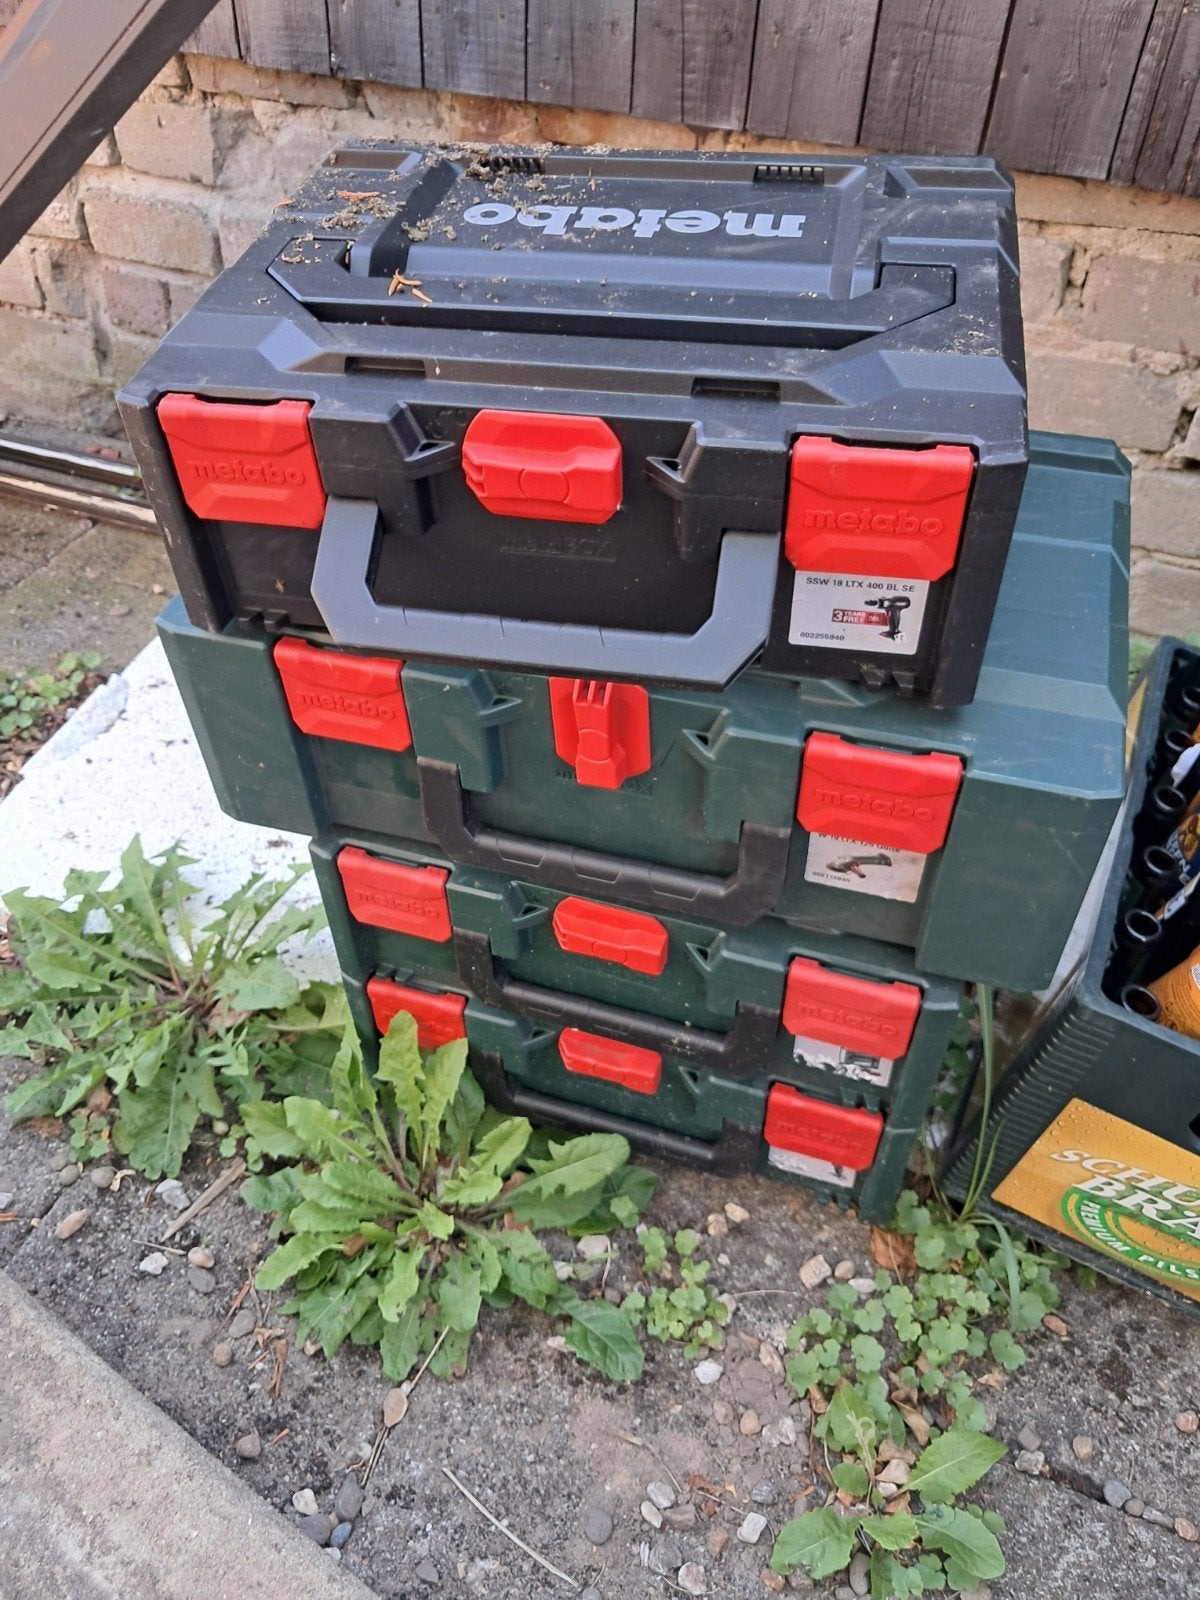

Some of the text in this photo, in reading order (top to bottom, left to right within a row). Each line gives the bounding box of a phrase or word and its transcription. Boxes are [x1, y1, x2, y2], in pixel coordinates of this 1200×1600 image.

[463, 203, 806, 238] metabo
[187, 460, 306, 486] metabo
[804, 509, 943, 536] metabo
[806, 577, 829, 586] SSW
[833, 609, 843, 621] 3
[296, 690, 396, 721] metabo
[813, 788, 935, 823] metabo
[354, 889, 440, 919] metabo
[798, 1002, 897, 1037] metabo
[776, 1120, 863, 1151] metabo
